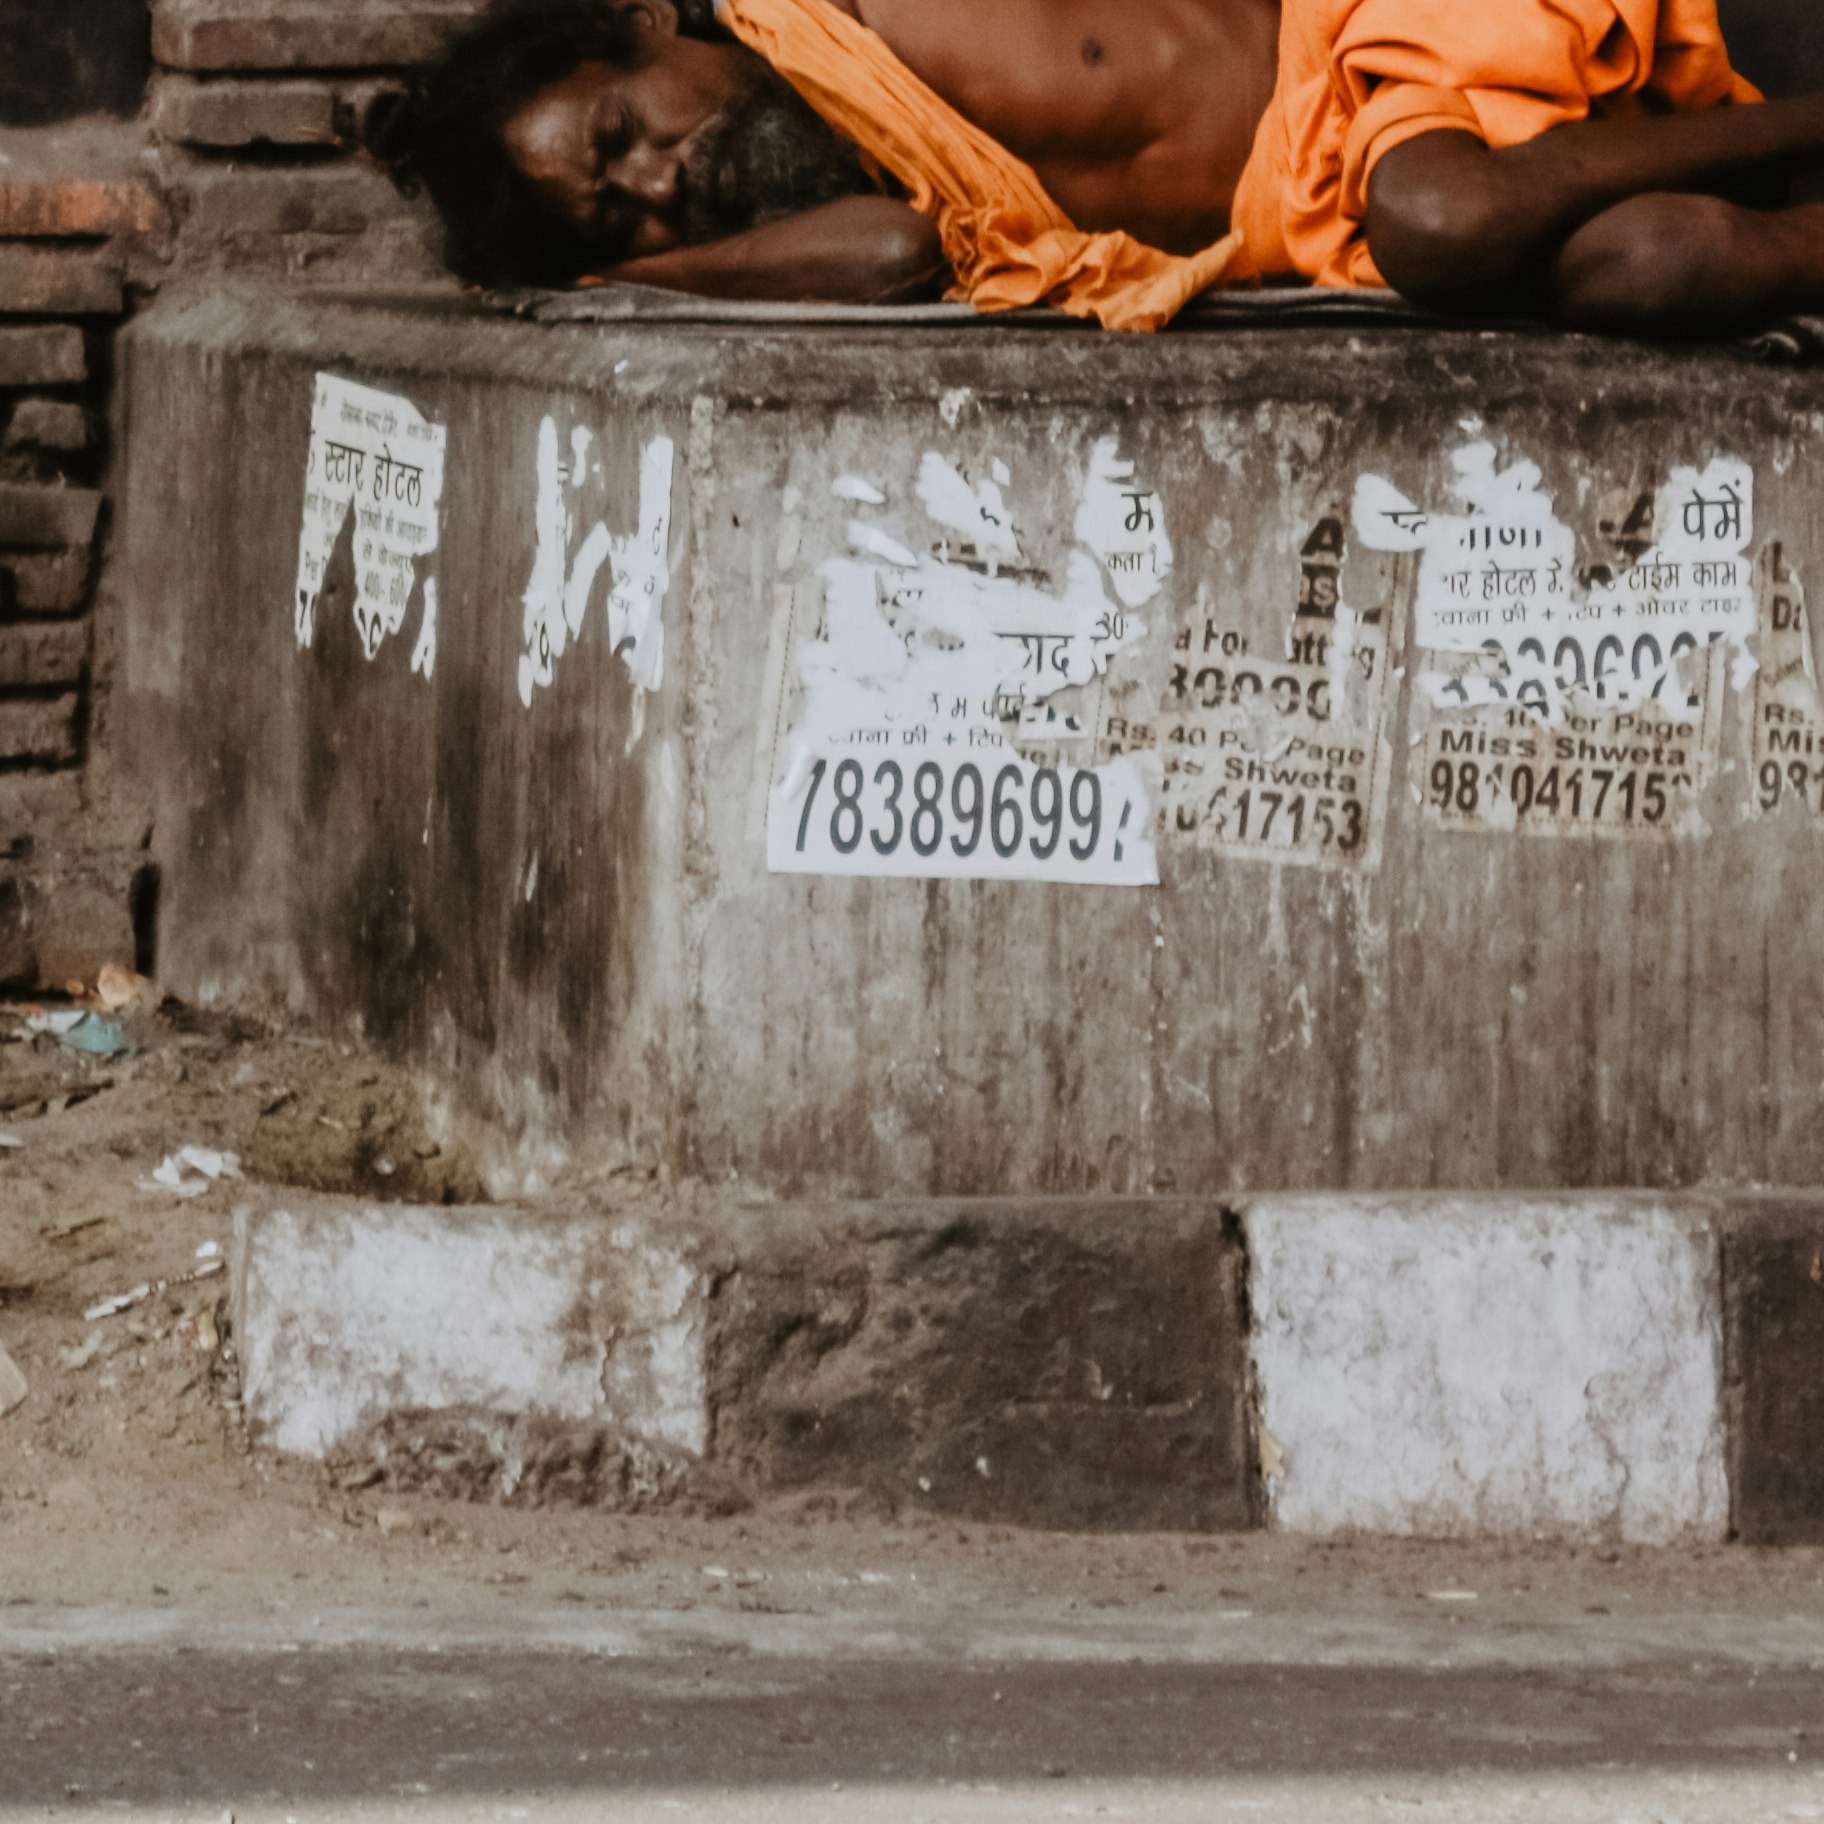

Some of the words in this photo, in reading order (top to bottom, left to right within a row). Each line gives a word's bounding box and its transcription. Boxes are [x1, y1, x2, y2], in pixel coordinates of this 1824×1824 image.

[372, 442, 424, 509] होटल
[1440, 728, 1539, 760] Miss
[1554, 735, 1687, 769] Shweta
[1224, 756, 1358, 794] Shweta
